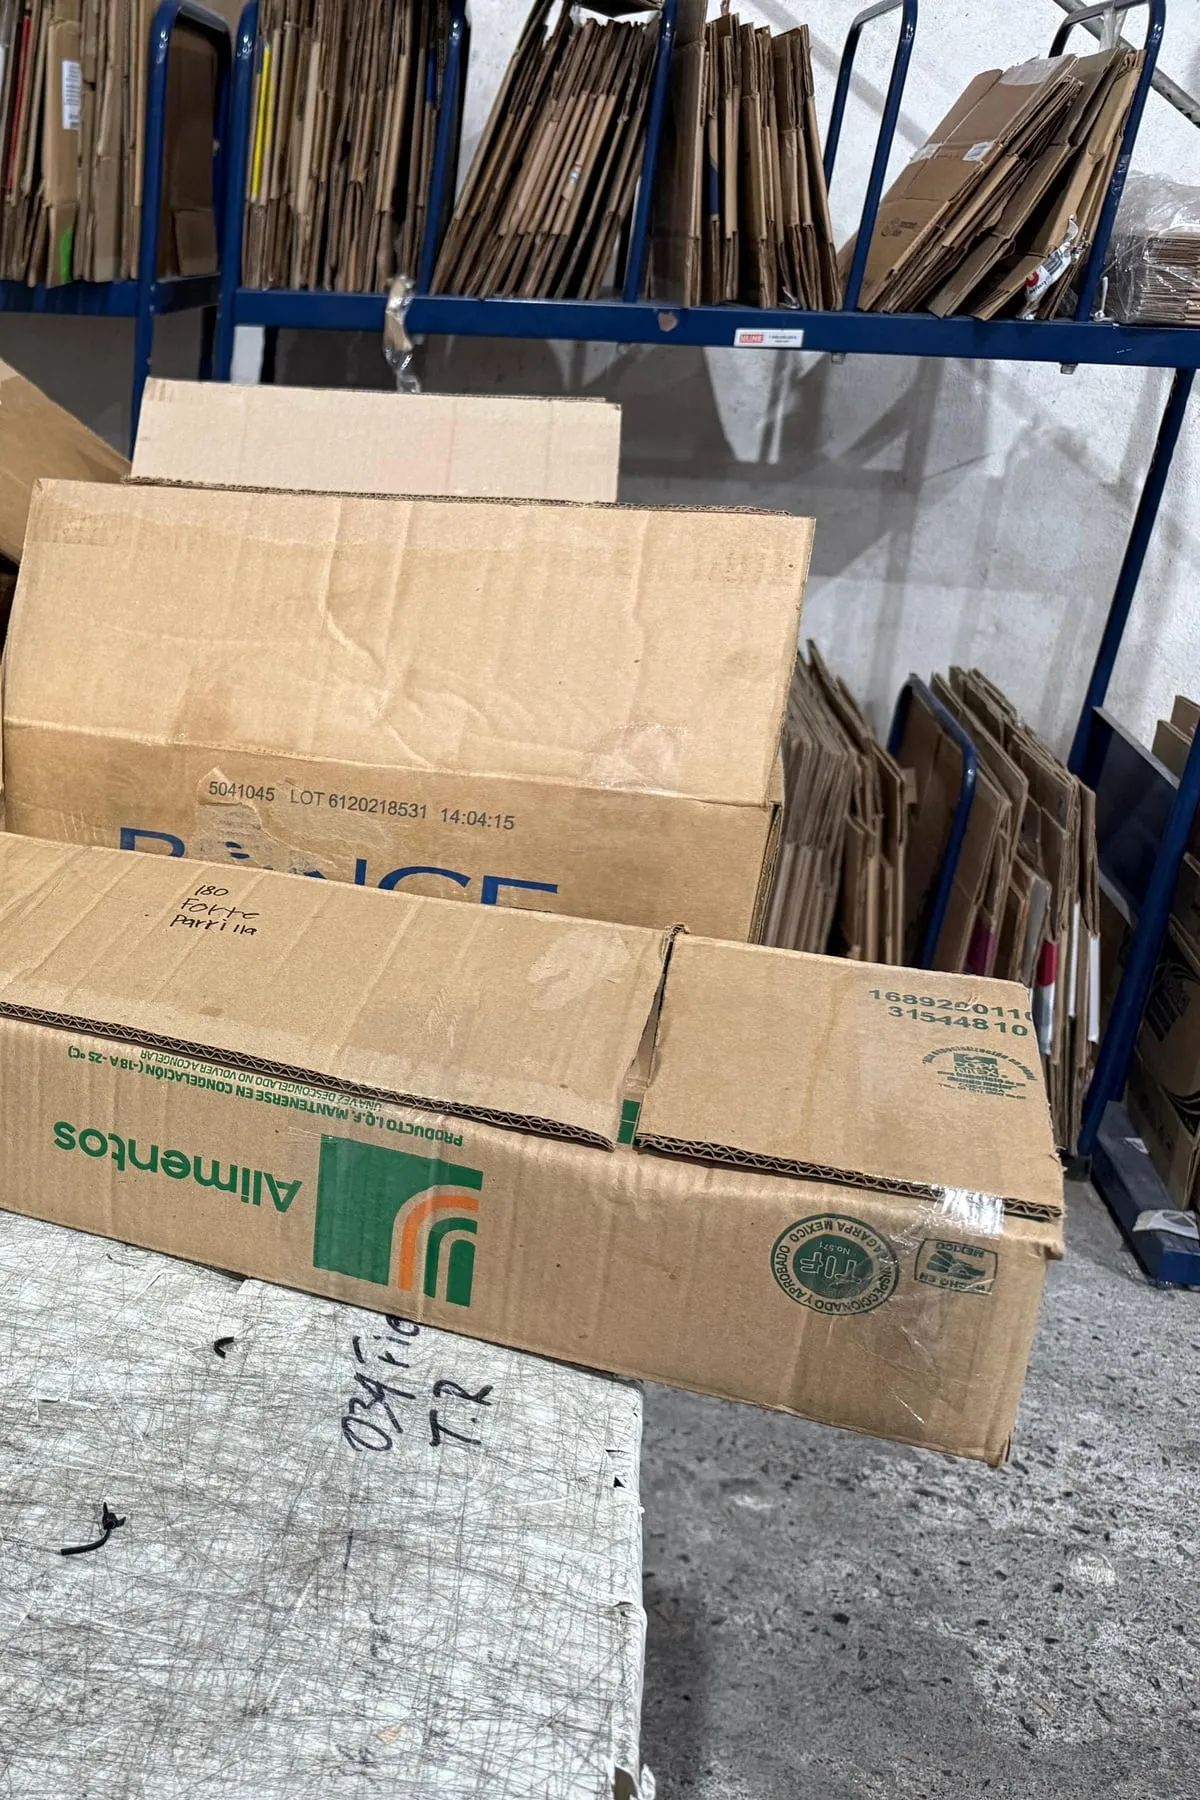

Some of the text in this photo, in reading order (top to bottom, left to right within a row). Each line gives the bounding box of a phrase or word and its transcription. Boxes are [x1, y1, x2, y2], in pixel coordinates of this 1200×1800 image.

[208, 781, 515, 831] 5041045 LOT 6120218531 14:04:15
[194, 884, 229, 898] 180
[140, 1049, 381, 1111] UNA VEZ DESCONGELADO NO VOLVER CONGELAR
[145, 1064, 232, 1094] CONGELACIÓN
[235, 1084, 253, 1099] EN
[255, 1089, 347, 1119] MANTENERSE
[385, 1118, 463, 1146] PRODUCTO
[52, 1121, 303, 1213] Alimentos
[789, 1220, 833, 1243] MEXICO
[775, 1245, 807, 1300] APROBADO
